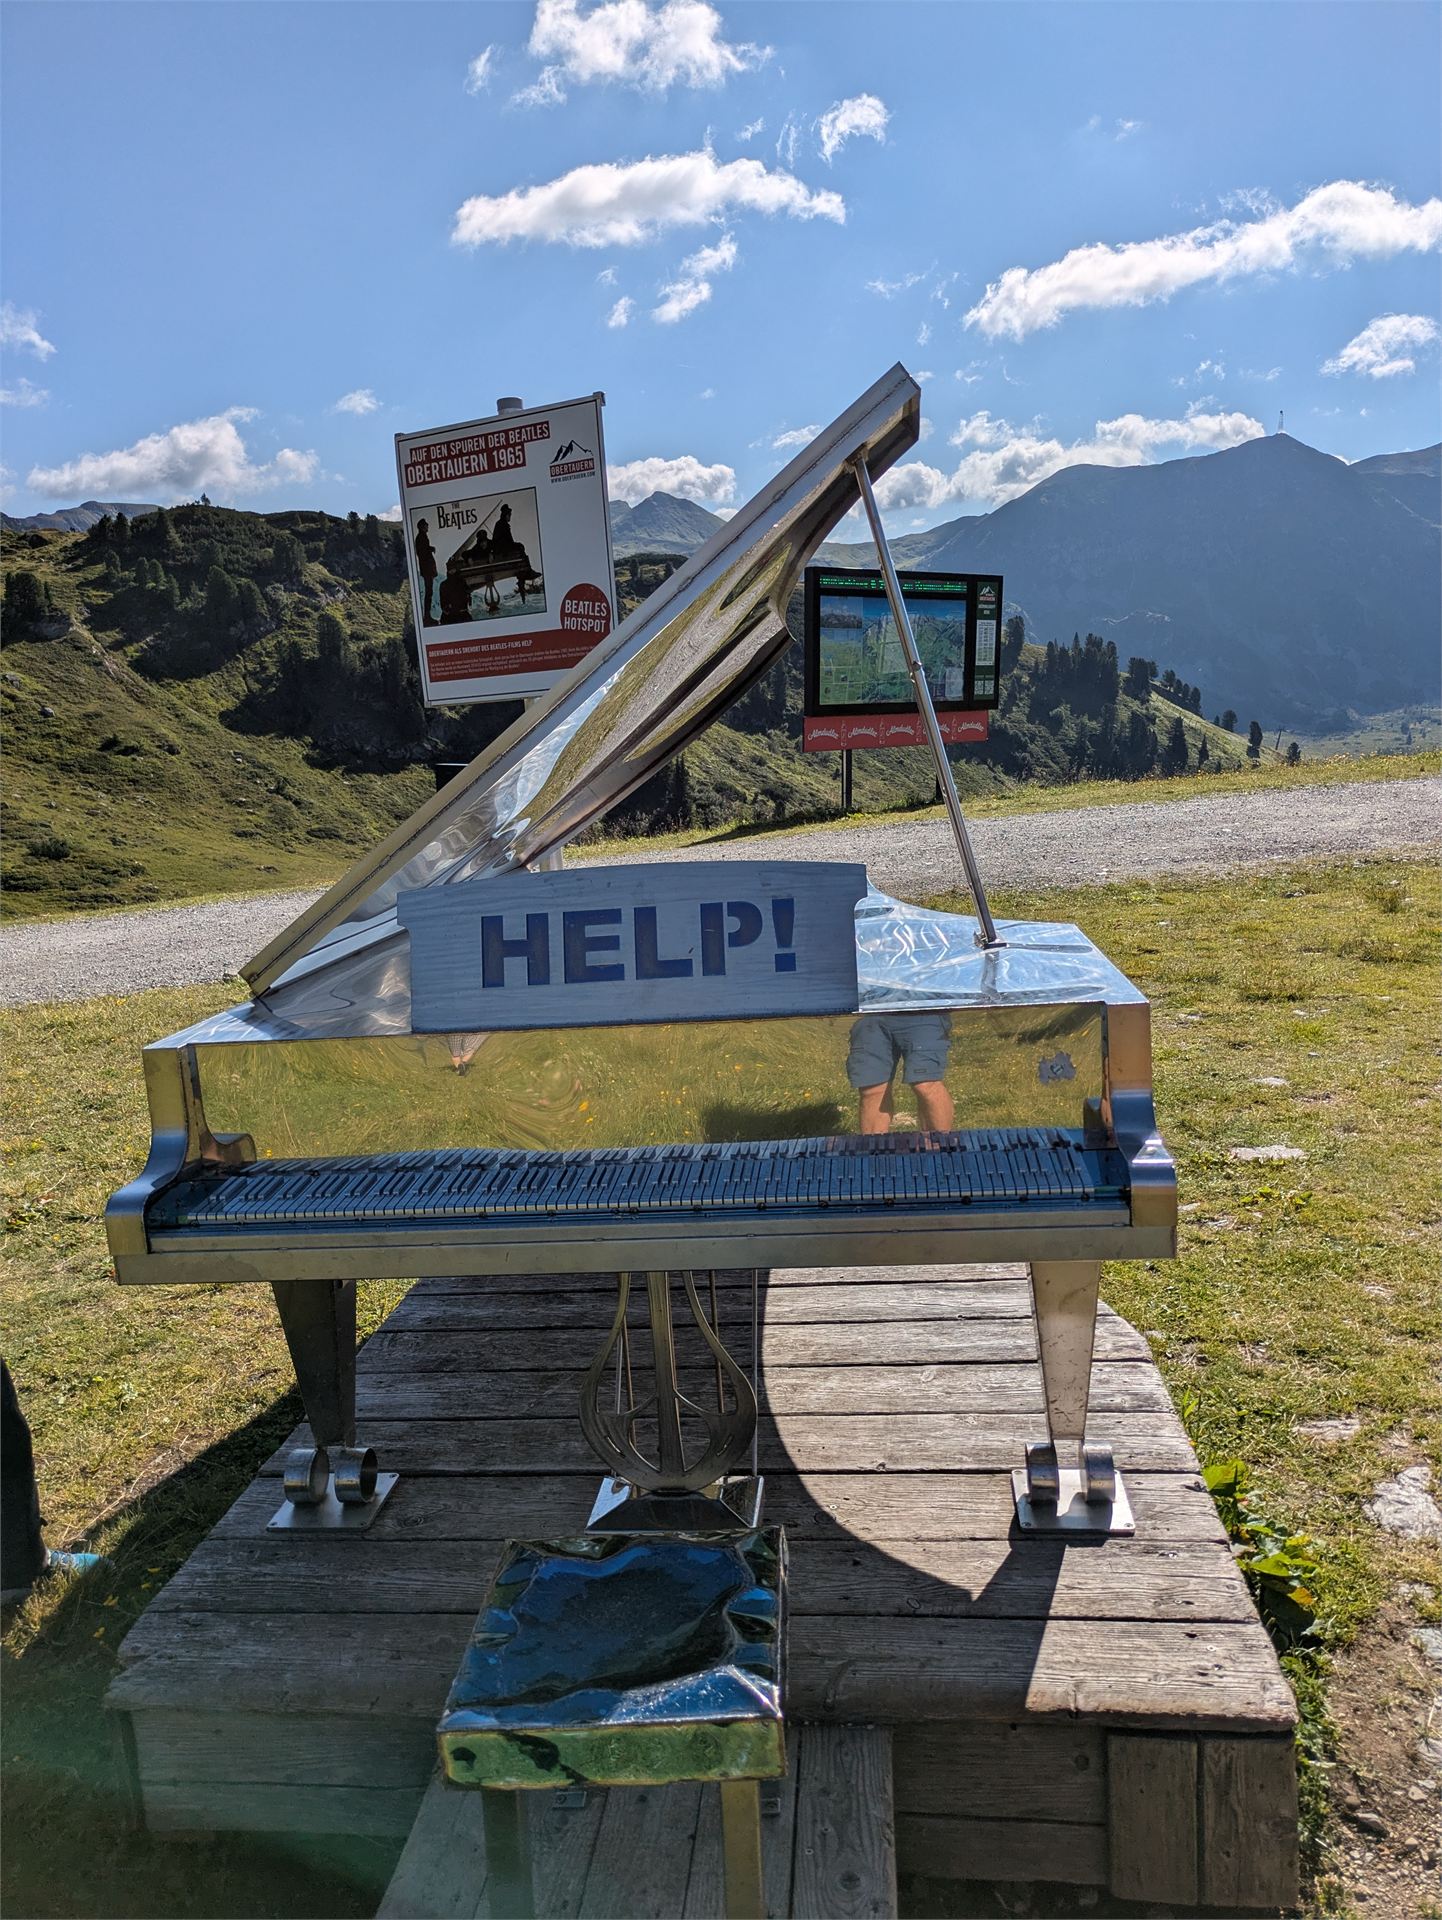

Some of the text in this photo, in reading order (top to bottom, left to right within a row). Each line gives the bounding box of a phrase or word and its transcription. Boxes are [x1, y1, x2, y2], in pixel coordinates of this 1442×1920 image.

[411, 423, 549, 463] AUF DEN SPUREN DER BEATLES
[407, 446, 524, 484] OBERTAUERN 1965
[551, 459, 594, 476] OBERTAUERN
[436, 506, 478, 530] BEATLES
[564, 600, 608, 617] BEATLES
[563, 616, 606, 633] HOTSPOT
[454, 647, 462, 655] ALS
[481, 644, 490, 652] DES
[521, 639, 533, 647] HELP
[480, 896, 797, 989] HELP!
